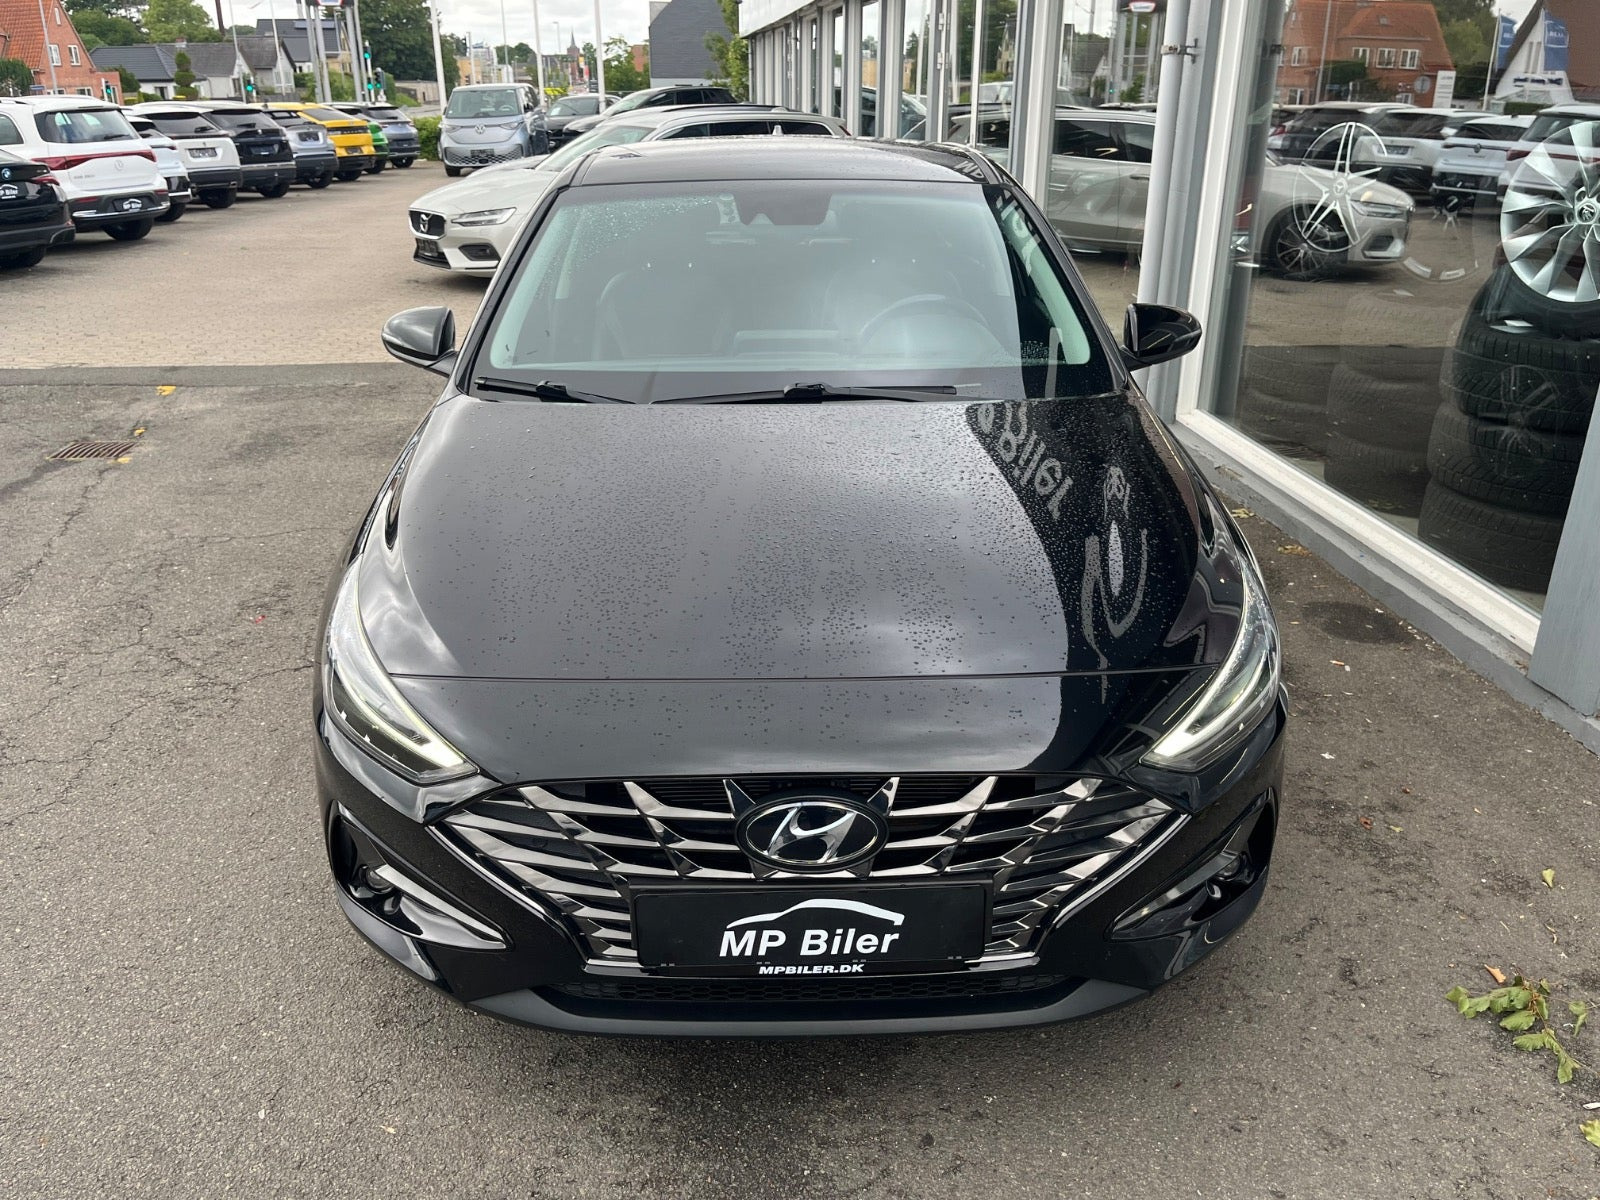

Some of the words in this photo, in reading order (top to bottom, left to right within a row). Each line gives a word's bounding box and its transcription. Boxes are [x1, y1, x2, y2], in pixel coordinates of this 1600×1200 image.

[719, 929, 787, 957] MP
[799, 927, 900, 956] Biler
[758, 963, 864, 976] MPBILER.DK
